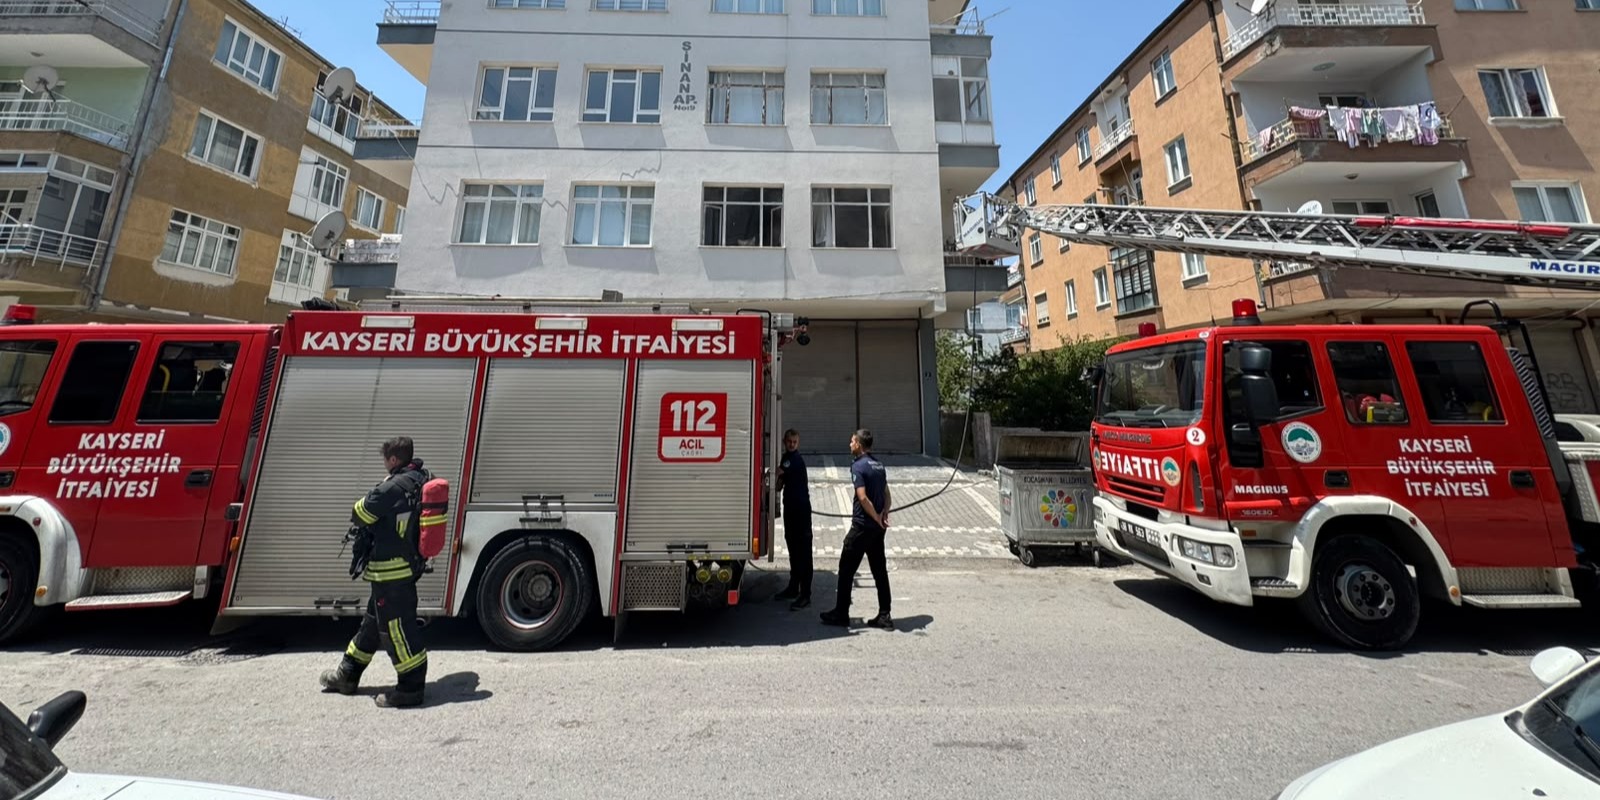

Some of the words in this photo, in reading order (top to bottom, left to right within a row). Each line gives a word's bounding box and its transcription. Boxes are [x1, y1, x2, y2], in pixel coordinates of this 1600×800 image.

[673, 95, 697, 105] AP.
[302, 328, 415, 351] KAYSERİ
[424, 328, 601, 357] BÜYÜKŞEHİR
[611, 330, 736, 355] İTFAİYESİ
[670, 400, 716, 432] 112
[78, 429, 165, 449] KAYSERİ
[1191, 430, 1200, 442] 2
[1398, 435, 1472, 453] KAYSERİ
[46, 453, 182, 478] BÜYÜKŞEHİR
[1386, 456, 1497, 477] BÜYÜKŞEHİR
[56, 477, 159, 498] İTFAİYESİ
[1234, 485, 1288, 494] MAGIRUS
[1404, 478, 1489, 496] İTFAİYESİ
